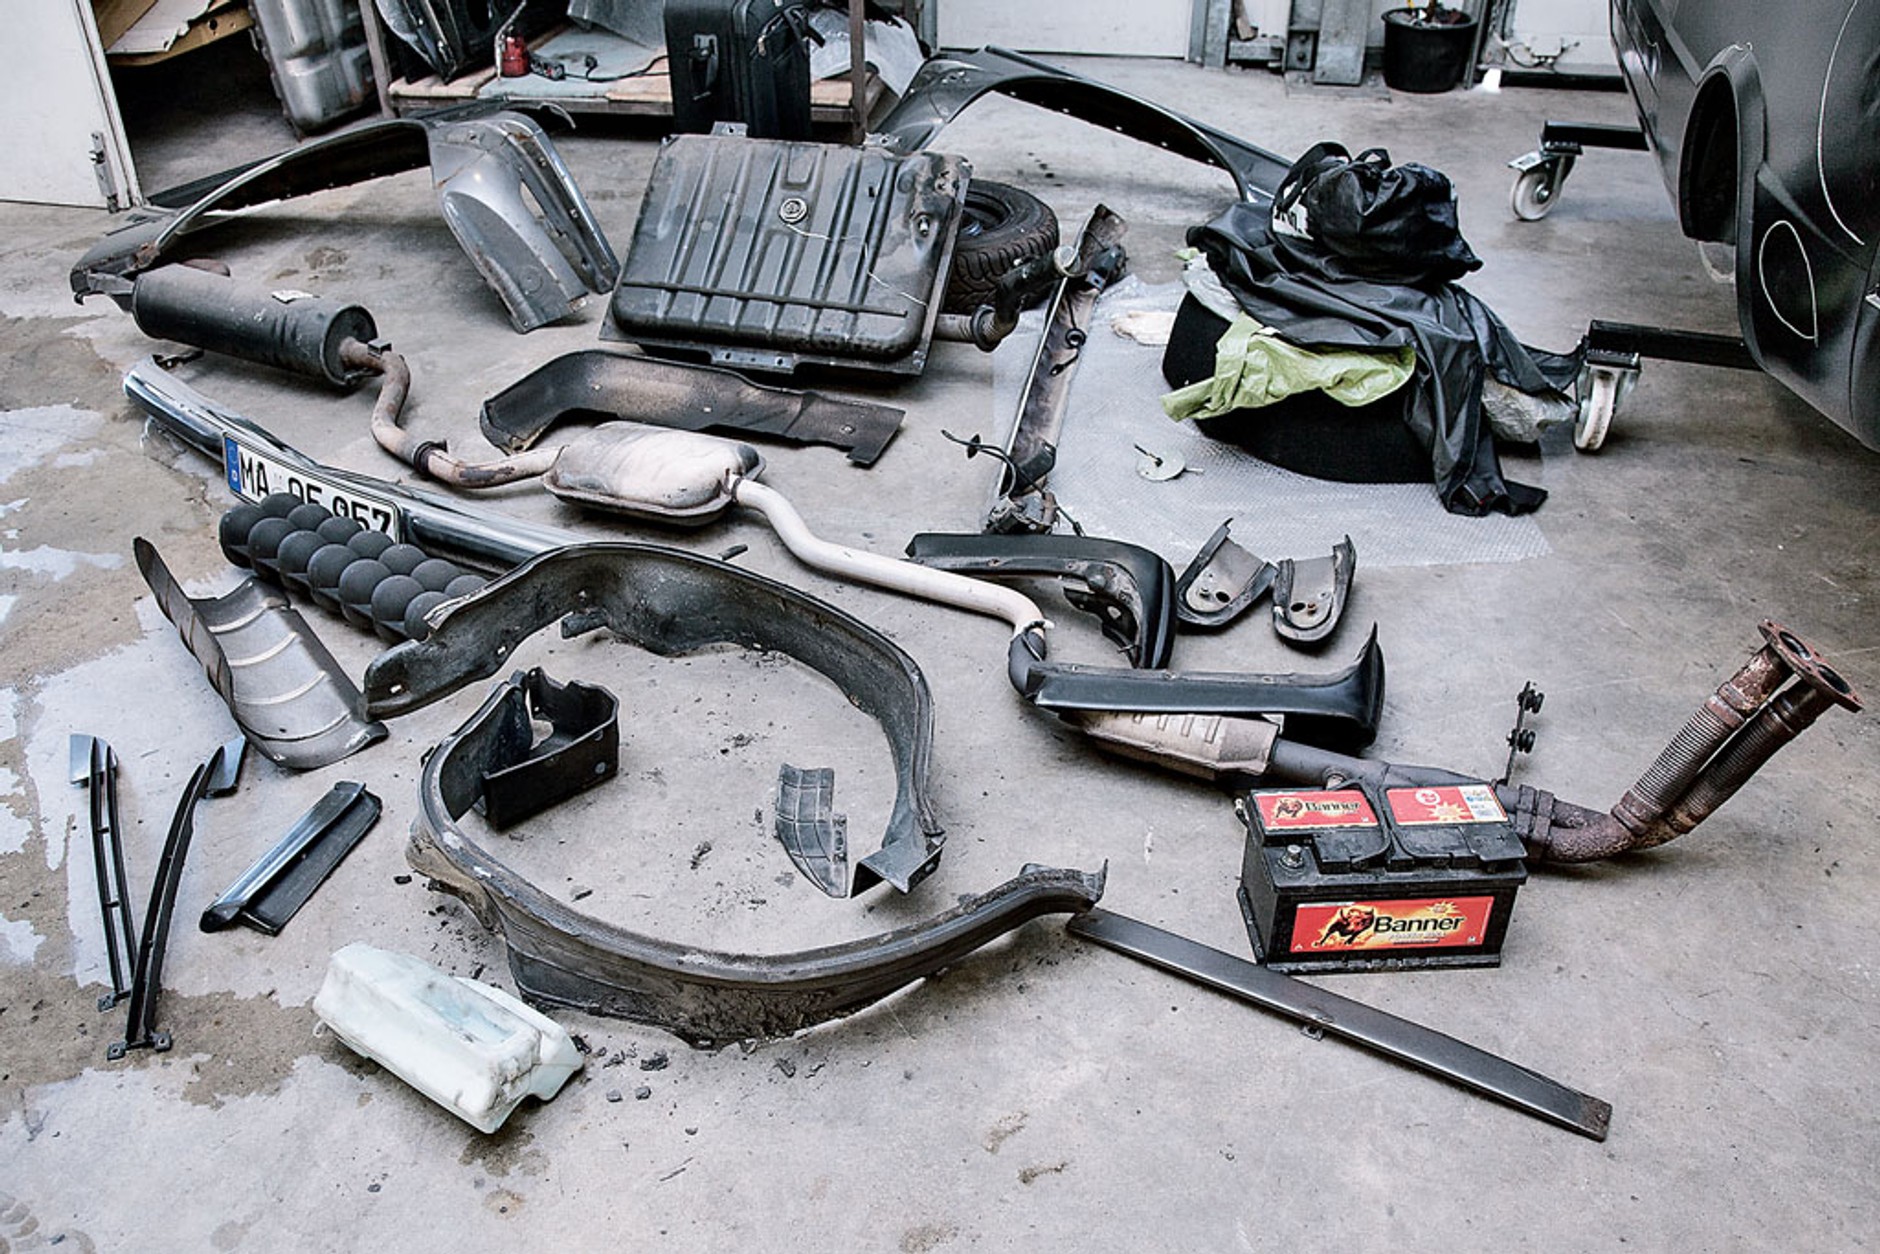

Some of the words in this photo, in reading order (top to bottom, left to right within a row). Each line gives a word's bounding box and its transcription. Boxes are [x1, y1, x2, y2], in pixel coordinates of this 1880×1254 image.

[240, 452, 269, 497] MA
[333, 496, 391, 534] 957
[1374, 916, 1465, 933] Banner
